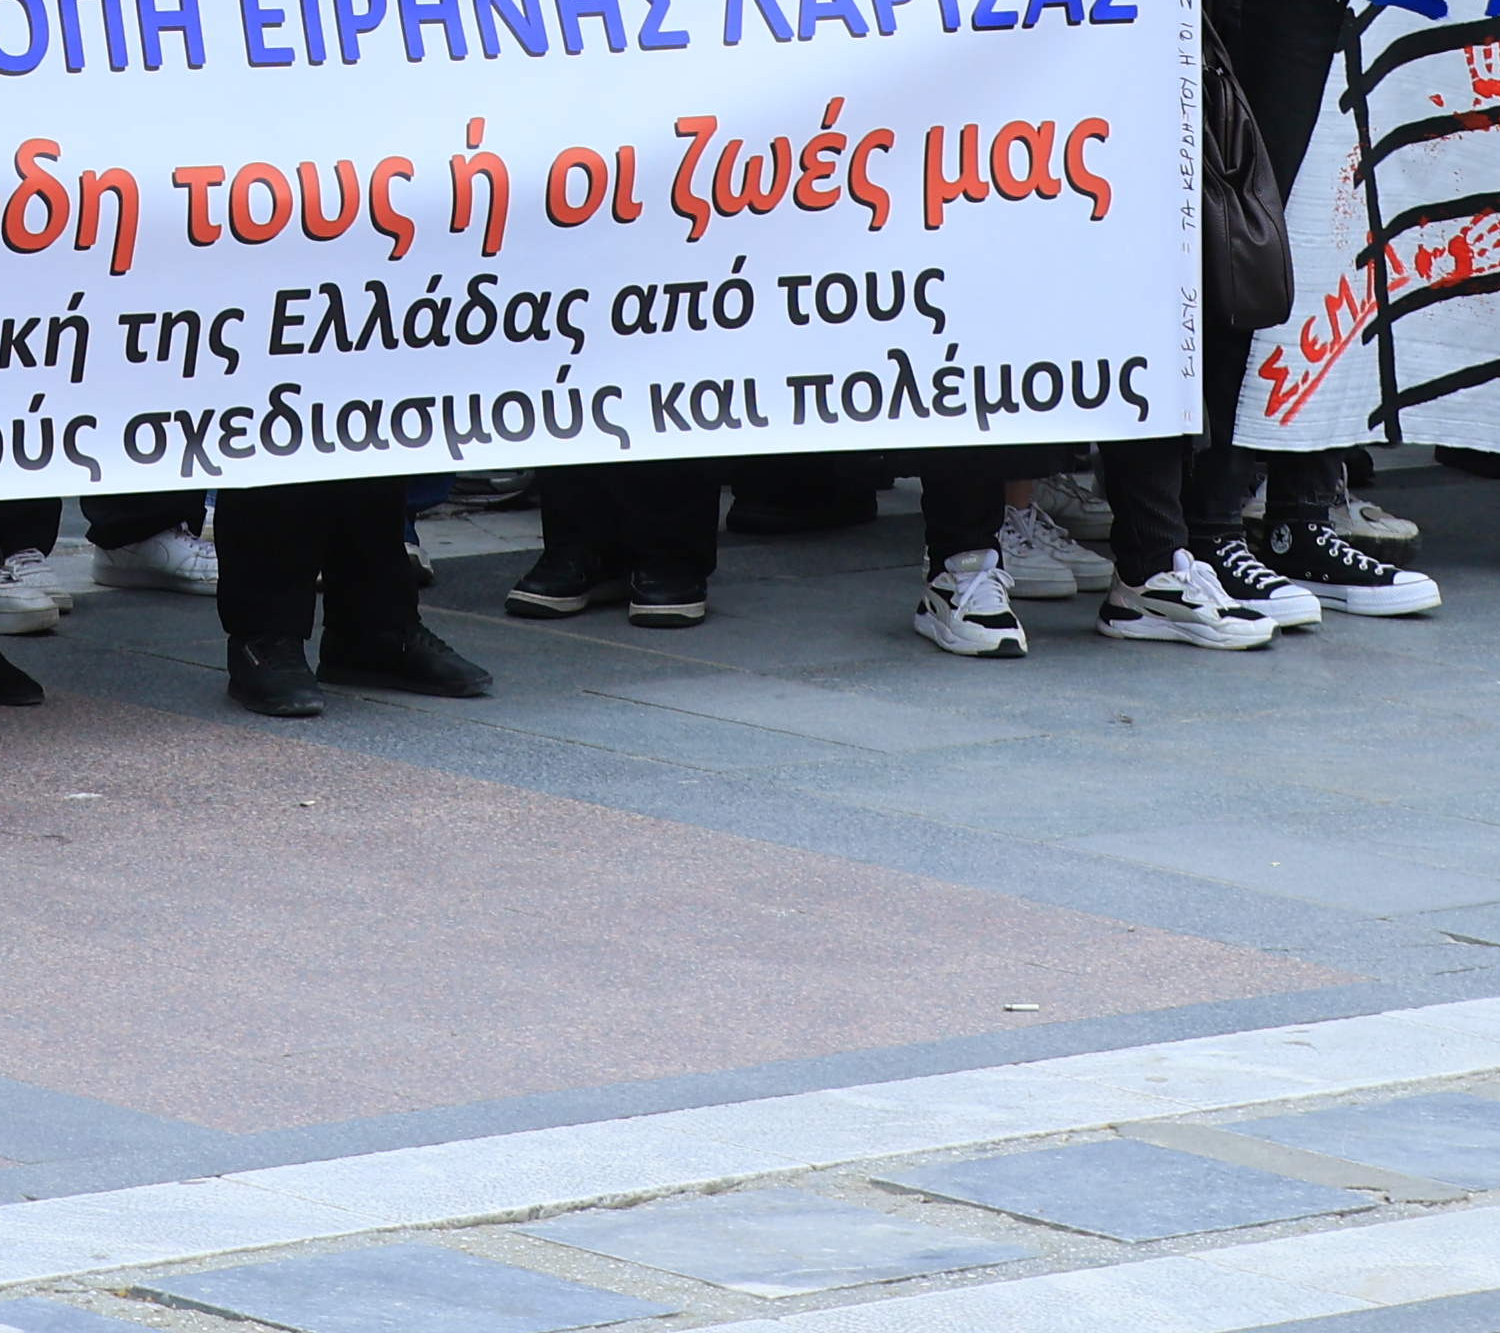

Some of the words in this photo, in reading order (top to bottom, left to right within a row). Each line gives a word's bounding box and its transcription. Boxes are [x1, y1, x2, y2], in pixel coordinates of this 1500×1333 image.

[173, 158, 414, 261] τους
[449, 117, 511, 258] ή
[545, 142, 643, 228] οι
[673, 97, 894, 244] ζωές
[924, 117, 1111, 230] μας
[118, 306, 243, 380] της
[269, 273, 587, 357] Ελλάδας
[611, 256, 754, 338] από
[778, 264, 946, 336] τους
[123, 363, 629, 478] σχεδιασμούς
[649, 379, 767, 435] και
[787, 342, 1150, 435] πολέμους
